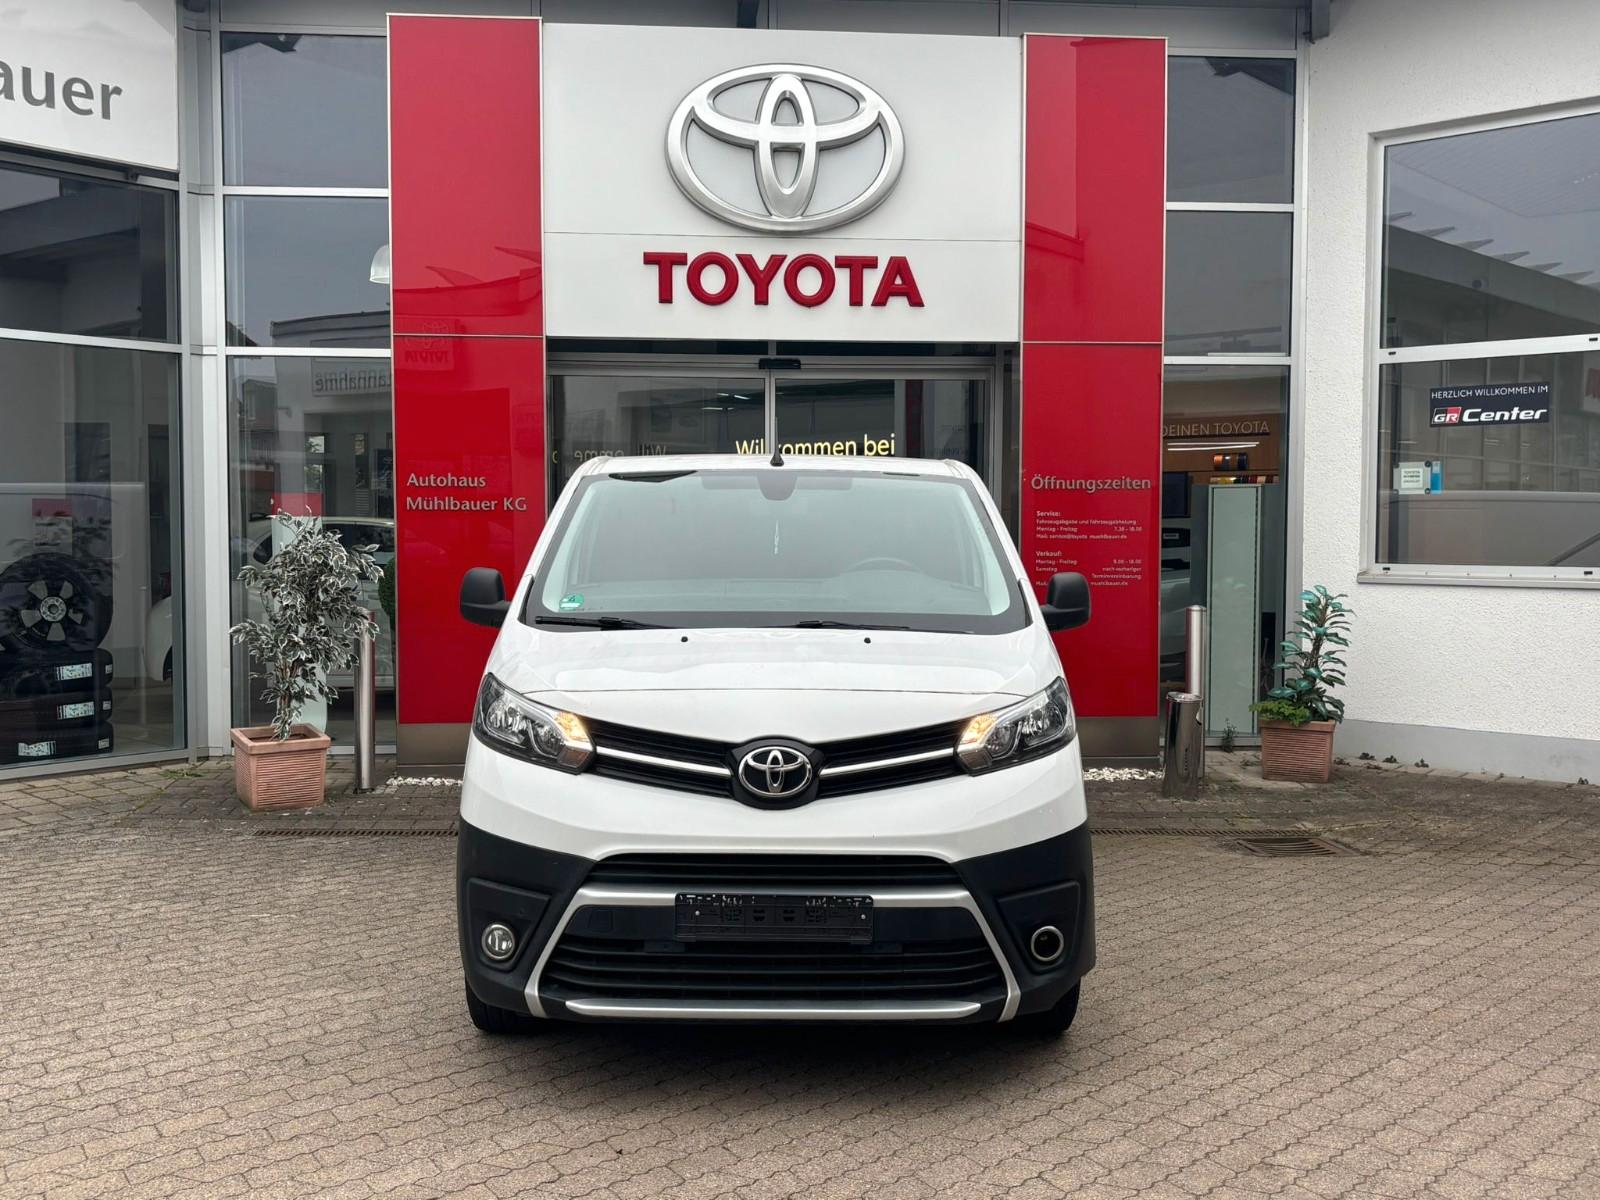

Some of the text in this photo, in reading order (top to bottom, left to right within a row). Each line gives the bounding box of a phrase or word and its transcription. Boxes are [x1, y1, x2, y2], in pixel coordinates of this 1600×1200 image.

[643, 251, 925, 307] TOYOTA
[1431, 385, 1549, 399] HERZLICH WILLKOMMEN IM
[1433, 406, 1548, 423] GR Center
[1213, 421, 1270, 434] TOYOTA
[864, 433, 895, 456] bei
[406, 473, 487, 487] Autohaus
[1031, 474, 1151, 493] Öffnungszeiten
[406, 496, 527, 511] Mühlbauer KG
